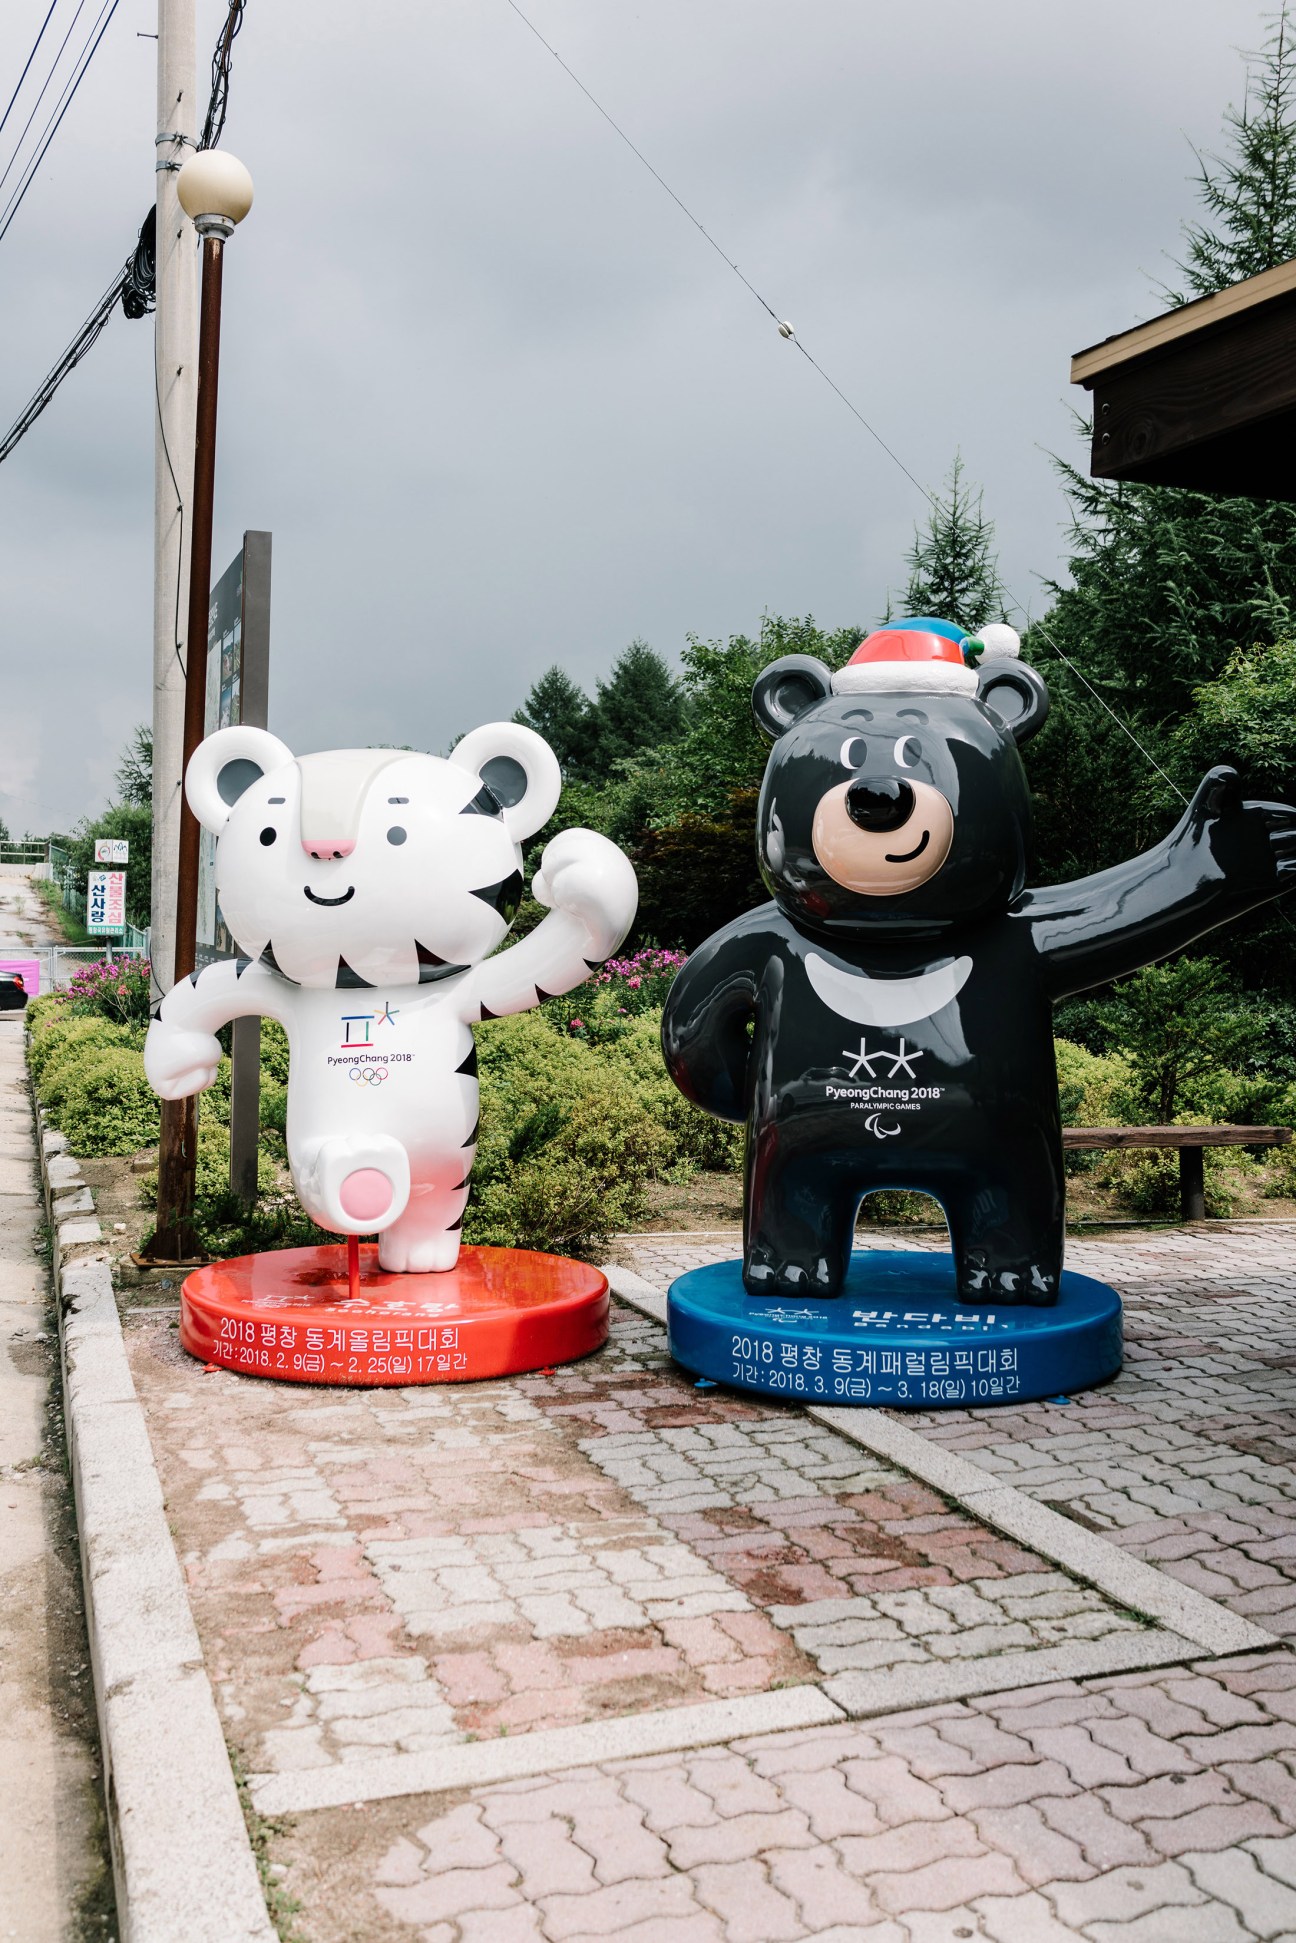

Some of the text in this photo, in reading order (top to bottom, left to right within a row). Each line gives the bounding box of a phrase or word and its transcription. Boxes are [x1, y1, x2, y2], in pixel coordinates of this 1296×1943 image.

[91, 885, 106, 923] 산사랑
[108, 873, 123, 924] 산불조심
[327, 1054, 389, 1066] PyeongChang
[826, 1086, 909, 1101] PyeongChang
[850, 1102, 894, 1110] PARALYMPIC
[333, 1298, 459, 1313] 수호랑
[852, 1310, 997, 1324] 반다비
[221, 1317, 459, 1352] 2018 평창 동계올림픽대회
[732, 1335, 1018, 1376] 2018 평창 동계패럴림픽대회
